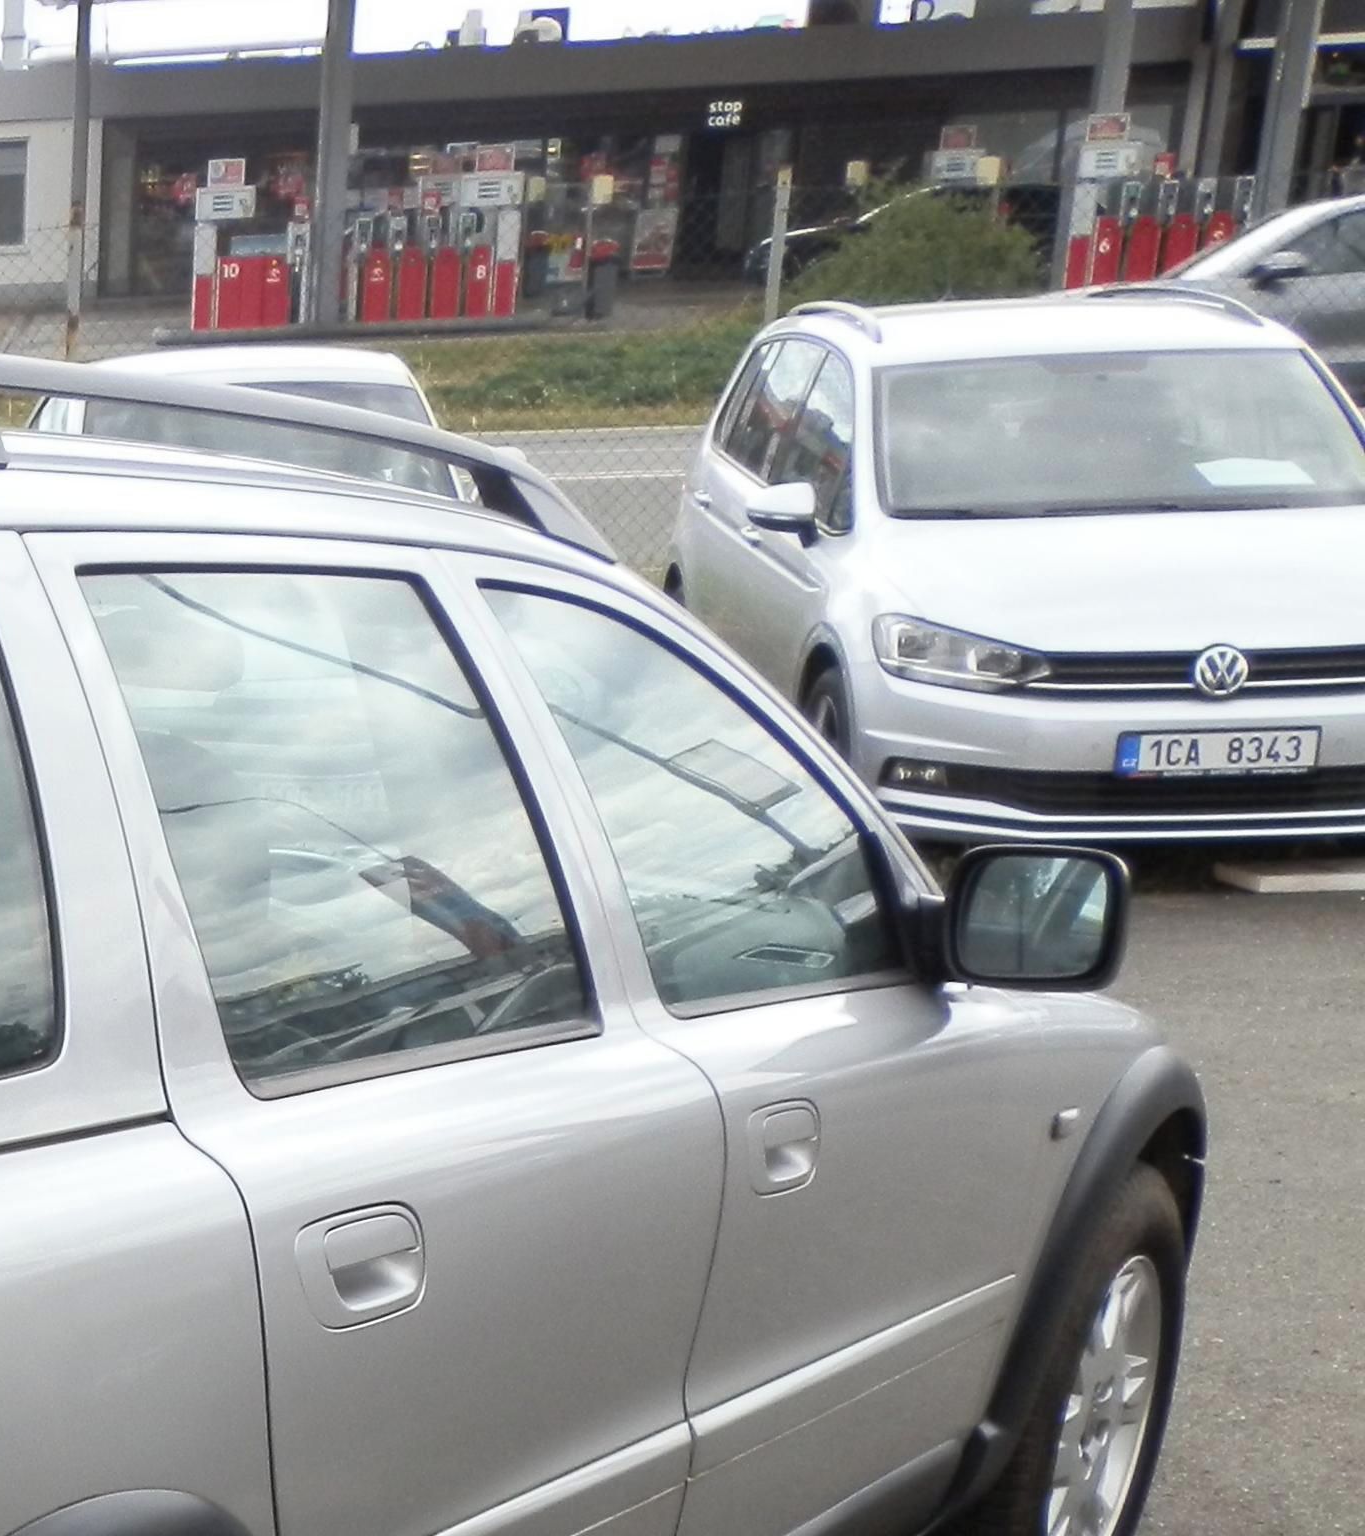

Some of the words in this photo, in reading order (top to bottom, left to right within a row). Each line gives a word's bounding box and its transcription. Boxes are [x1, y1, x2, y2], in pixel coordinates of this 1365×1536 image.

[709, 100, 743, 113] stop
[222, 263, 240, 278] 10
[476, 264, 486, 279] 8
[1150, 738, 1200, 767] 1CA
[1226, 735, 1302, 765] 8343
[1122, 757, 1138, 768] CZ
